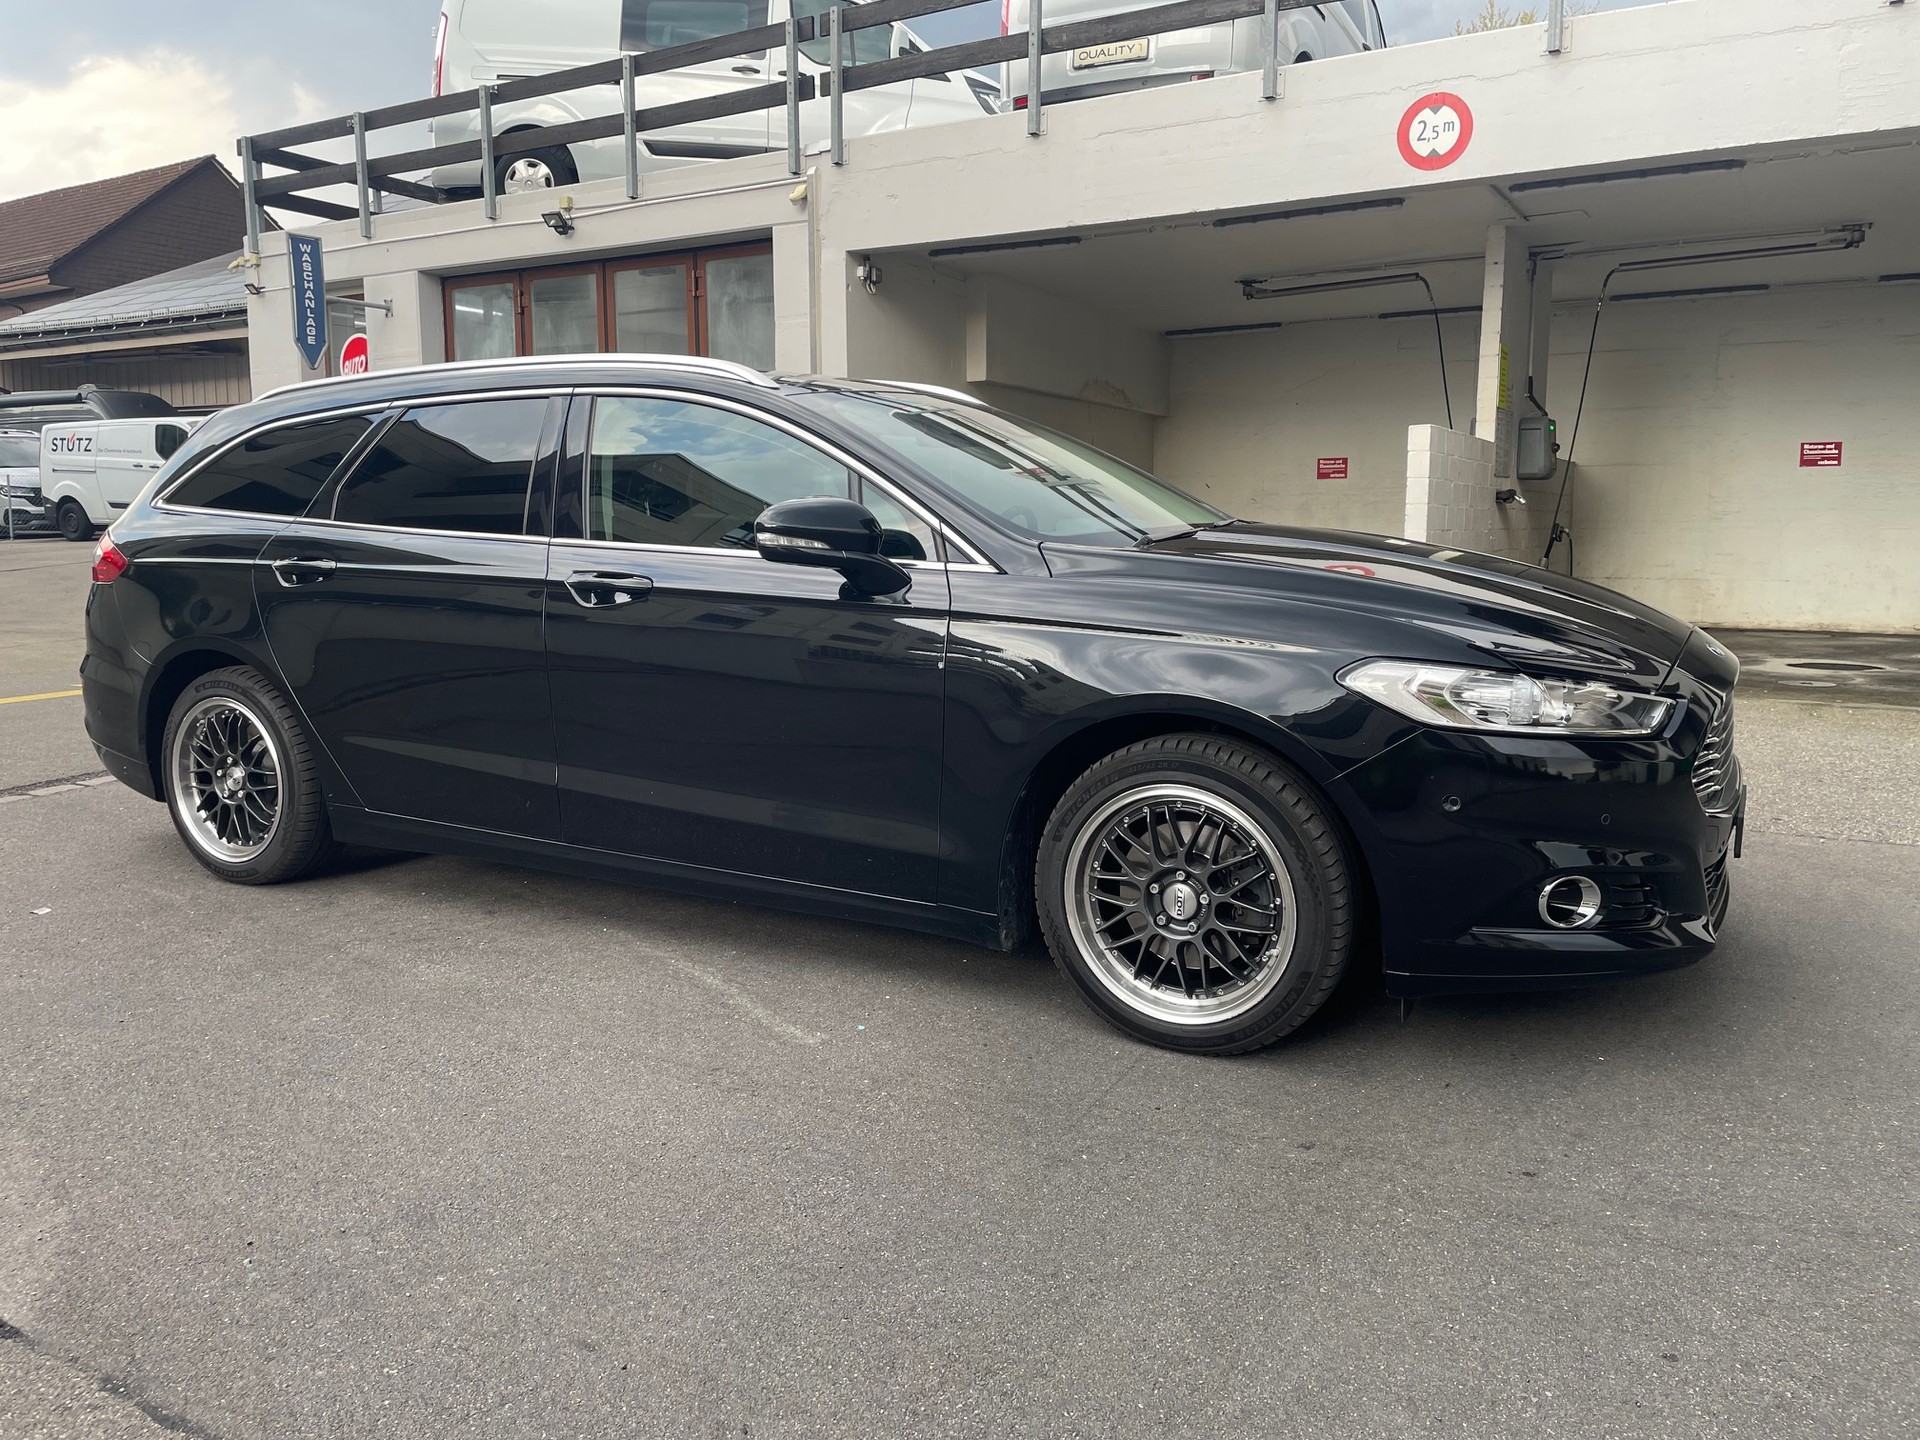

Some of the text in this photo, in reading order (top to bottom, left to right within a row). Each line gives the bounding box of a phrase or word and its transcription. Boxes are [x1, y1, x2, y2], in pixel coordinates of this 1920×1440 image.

[1079, 44, 1135, 60] QUALITY
[1417, 120, 1455, 142] 2,5 m
[299, 243, 316, 345] WASCHANLAGE
[343, 354, 366, 375] AUTO
[1065, 773, 1119, 820] MICHELIN
